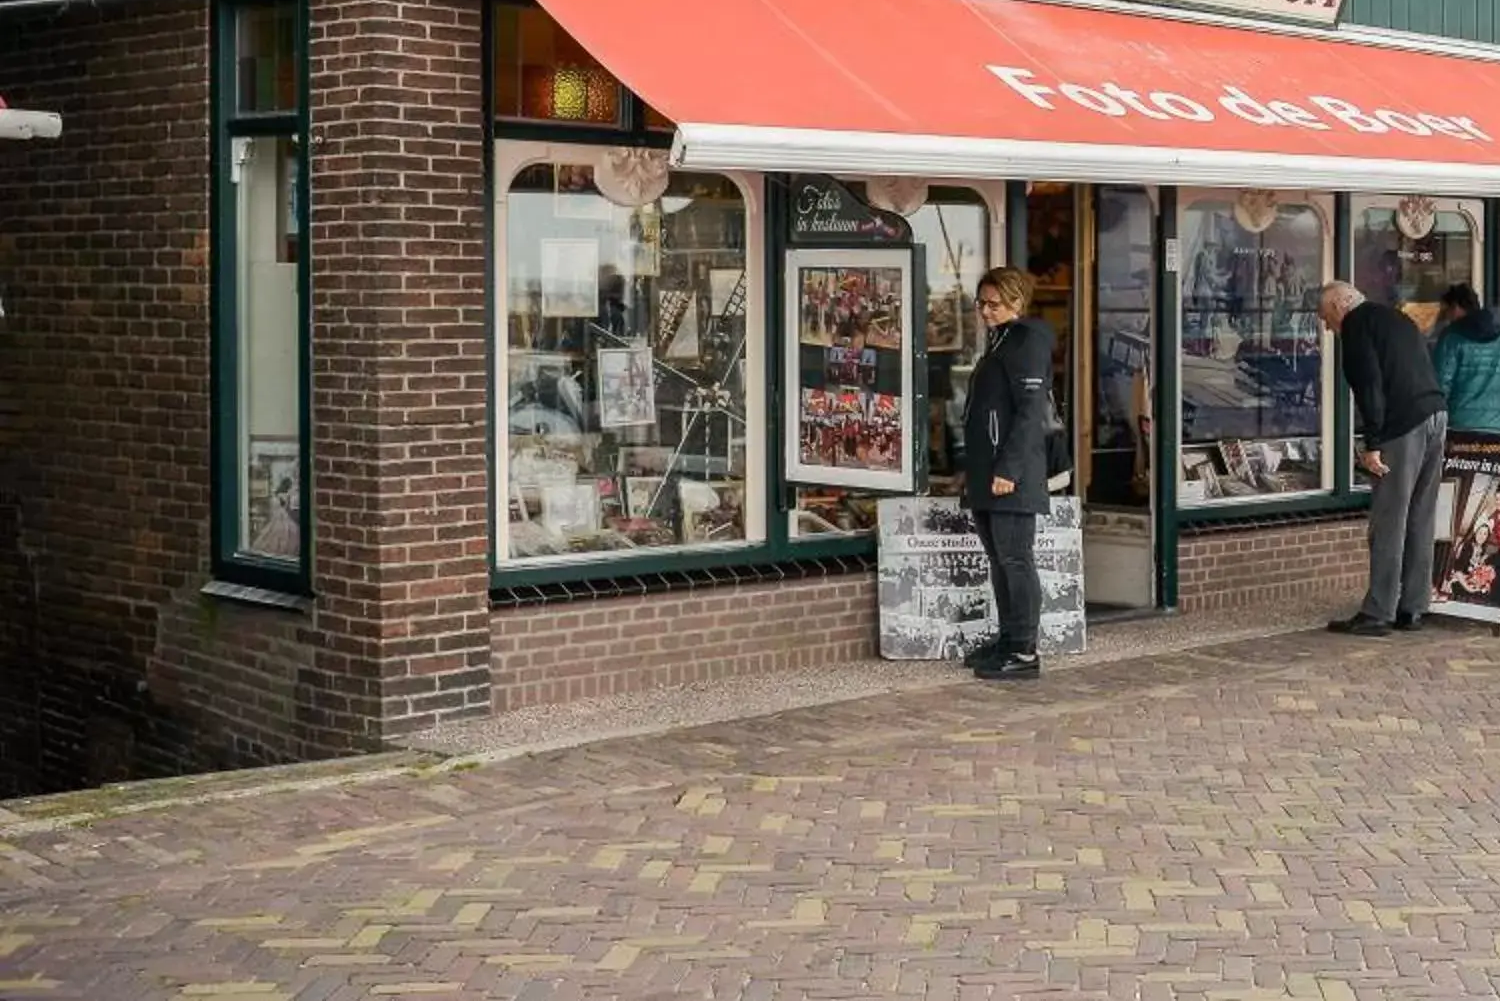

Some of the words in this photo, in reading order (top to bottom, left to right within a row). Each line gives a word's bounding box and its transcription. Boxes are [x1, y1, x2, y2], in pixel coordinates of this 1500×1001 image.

[985, 63, 1215, 123] Foto
[1217, 85, 1332, 131] de
[1310, 94, 1494, 143] Boer
